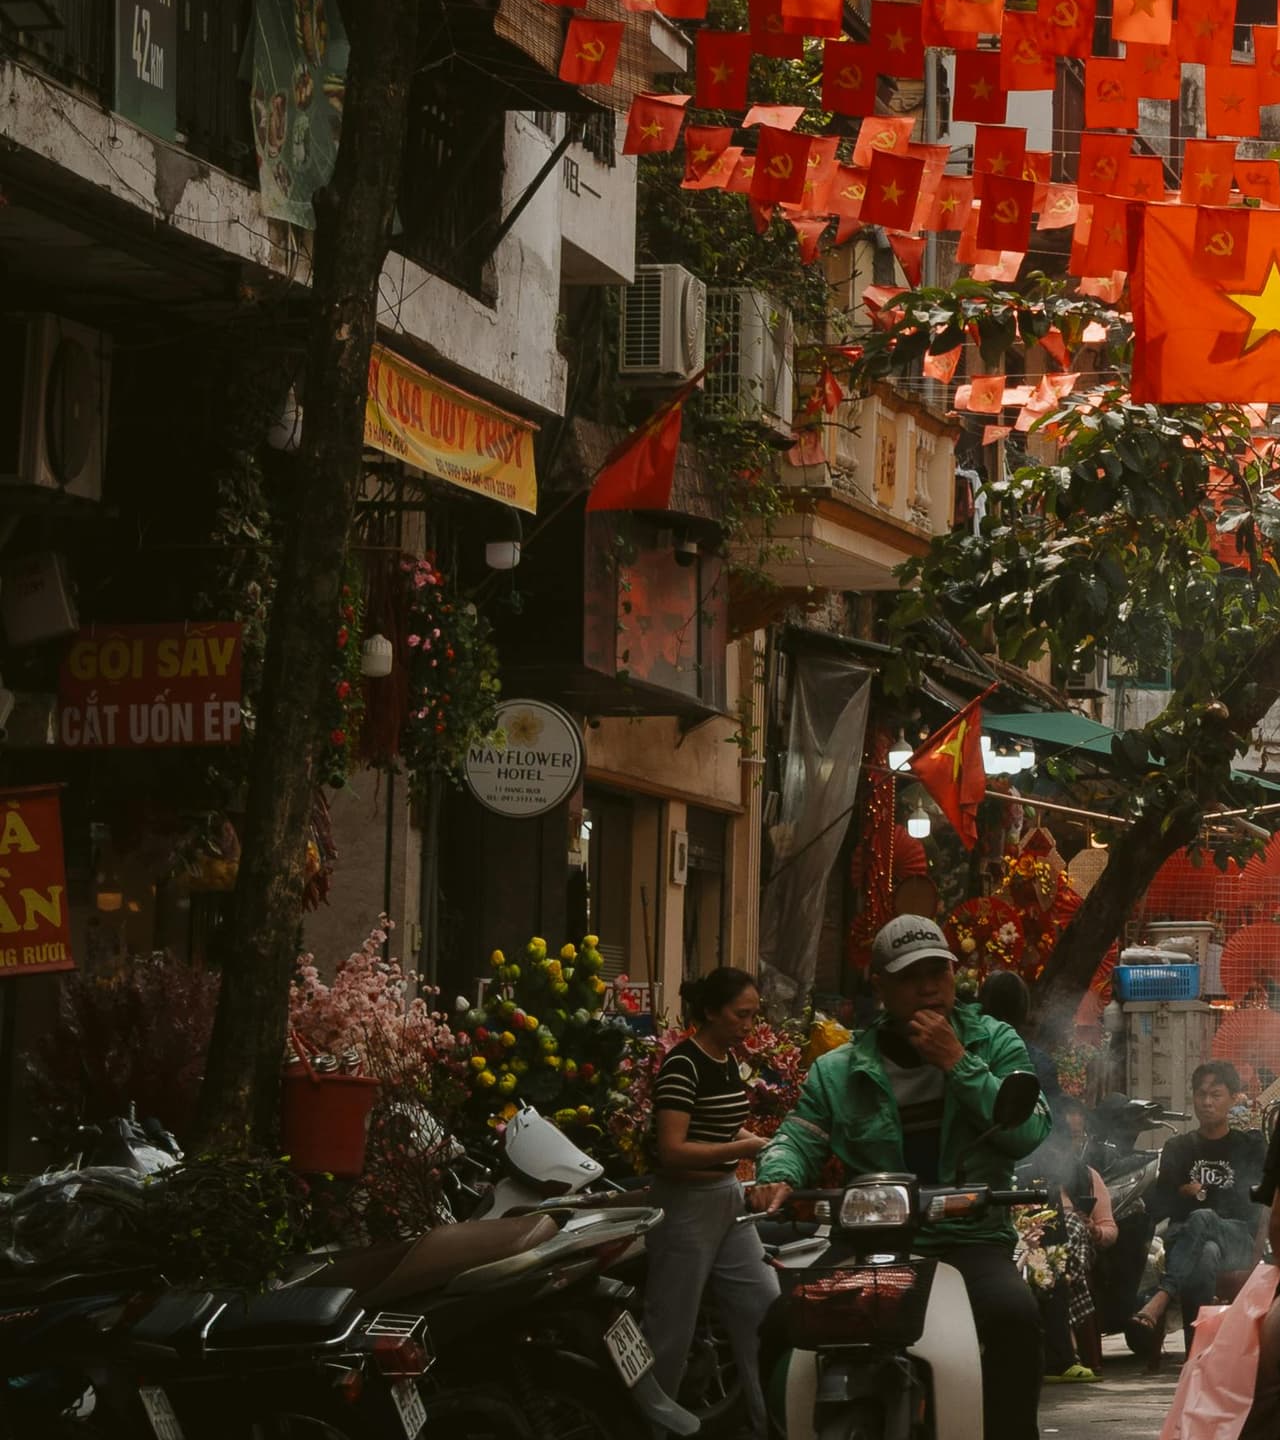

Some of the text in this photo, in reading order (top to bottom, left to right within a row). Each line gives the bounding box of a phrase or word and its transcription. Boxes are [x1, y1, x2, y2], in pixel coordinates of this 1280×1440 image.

[132, 4, 151, 83] 42
[428, 393, 468, 450] DUY
[69, 632, 144, 685] GỘI
[61, 688, 241, 747] CẮT UỐN ÉP
[469, 748, 574, 768] MAYFLOWER
[497, 768, 545, 781] HOTEL
[892, 929, 941, 949] adidas
